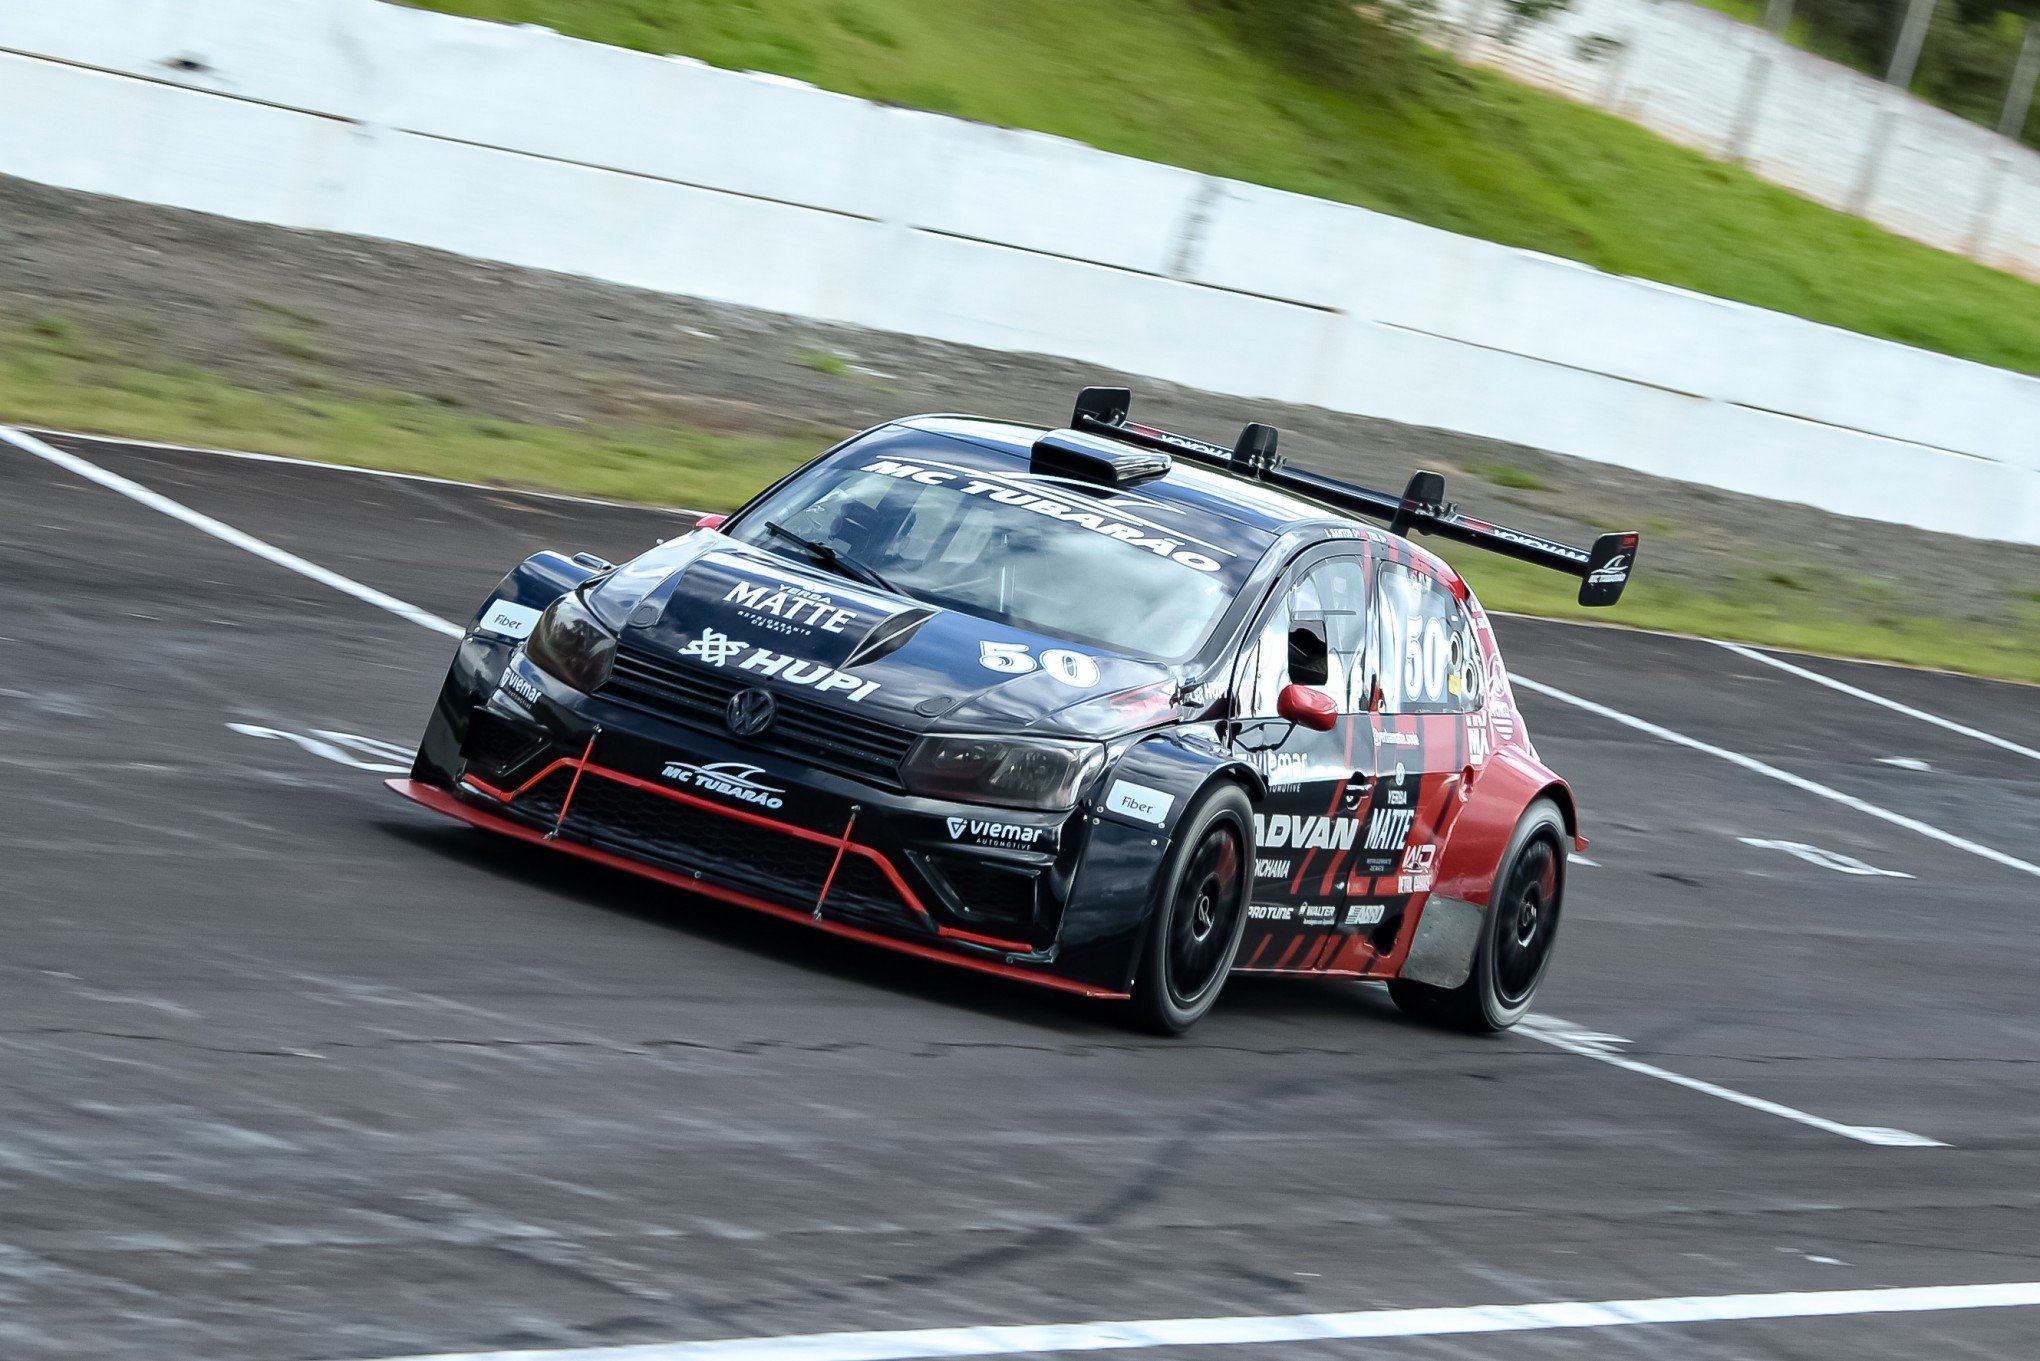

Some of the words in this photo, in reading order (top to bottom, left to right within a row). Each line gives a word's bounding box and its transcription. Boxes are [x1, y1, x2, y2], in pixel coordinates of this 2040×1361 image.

[860, 460, 957, 486] MC
[961, 480, 1222, 572] TUBARÃO
[723, 581, 858, 634] MATTE
[739, 647, 881, 702] HUPI
[978, 640, 1101, 688] 50
[1404, 615, 1444, 702] 50
[661, 765, 693, 782] MC
[976, 838, 1031, 850] AUTOMOTIVE
[1364, 808, 1415, 850] MATTE
[1306, 906, 1336, 917] WALTER
